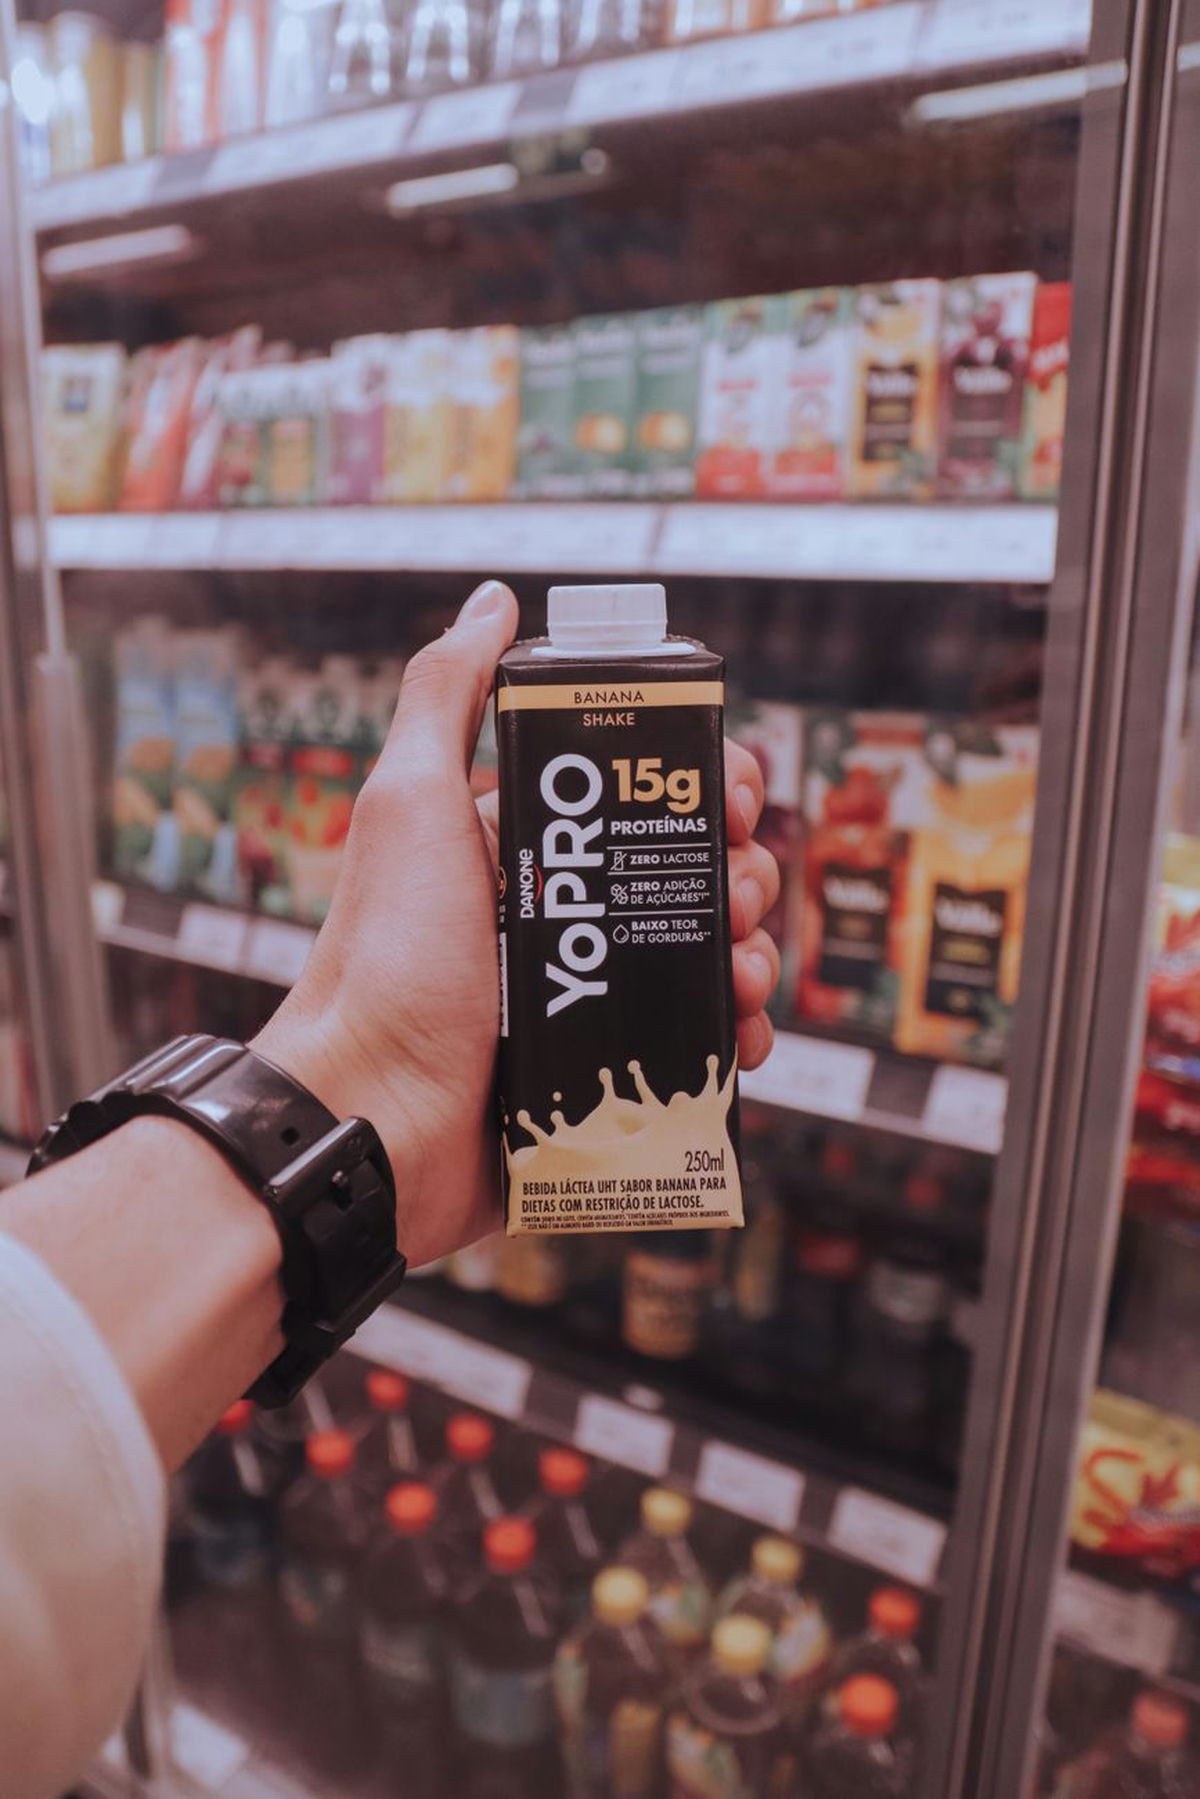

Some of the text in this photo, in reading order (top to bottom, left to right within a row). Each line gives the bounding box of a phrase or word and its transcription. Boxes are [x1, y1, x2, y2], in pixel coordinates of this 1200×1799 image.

[574, 690, 644, 704] BANANA
[583, 712, 636, 726] SHAKE
[612, 758, 700, 814] 15g
[610, 815, 707, 835] PROTEÍNAS
[630, 852, 710, 864] ZERO LACTOSE
[630, 877, 706, 892] ZERO ADIÇÃO
[630, 894, 644, 904] DE
[631, 920, 698, 931] BAIXO TEOR
[632, 934, 645, 944] DE
[684, 1148, 725, 1173] 250ml
[522, 1176, 726, 1196] BEBIDA LÁCTEA UHT SABOR BANANA PARA
[522, 1194, 704, 1213] DIETAS COM RESTRIÇÃO DE LACTOSE.
